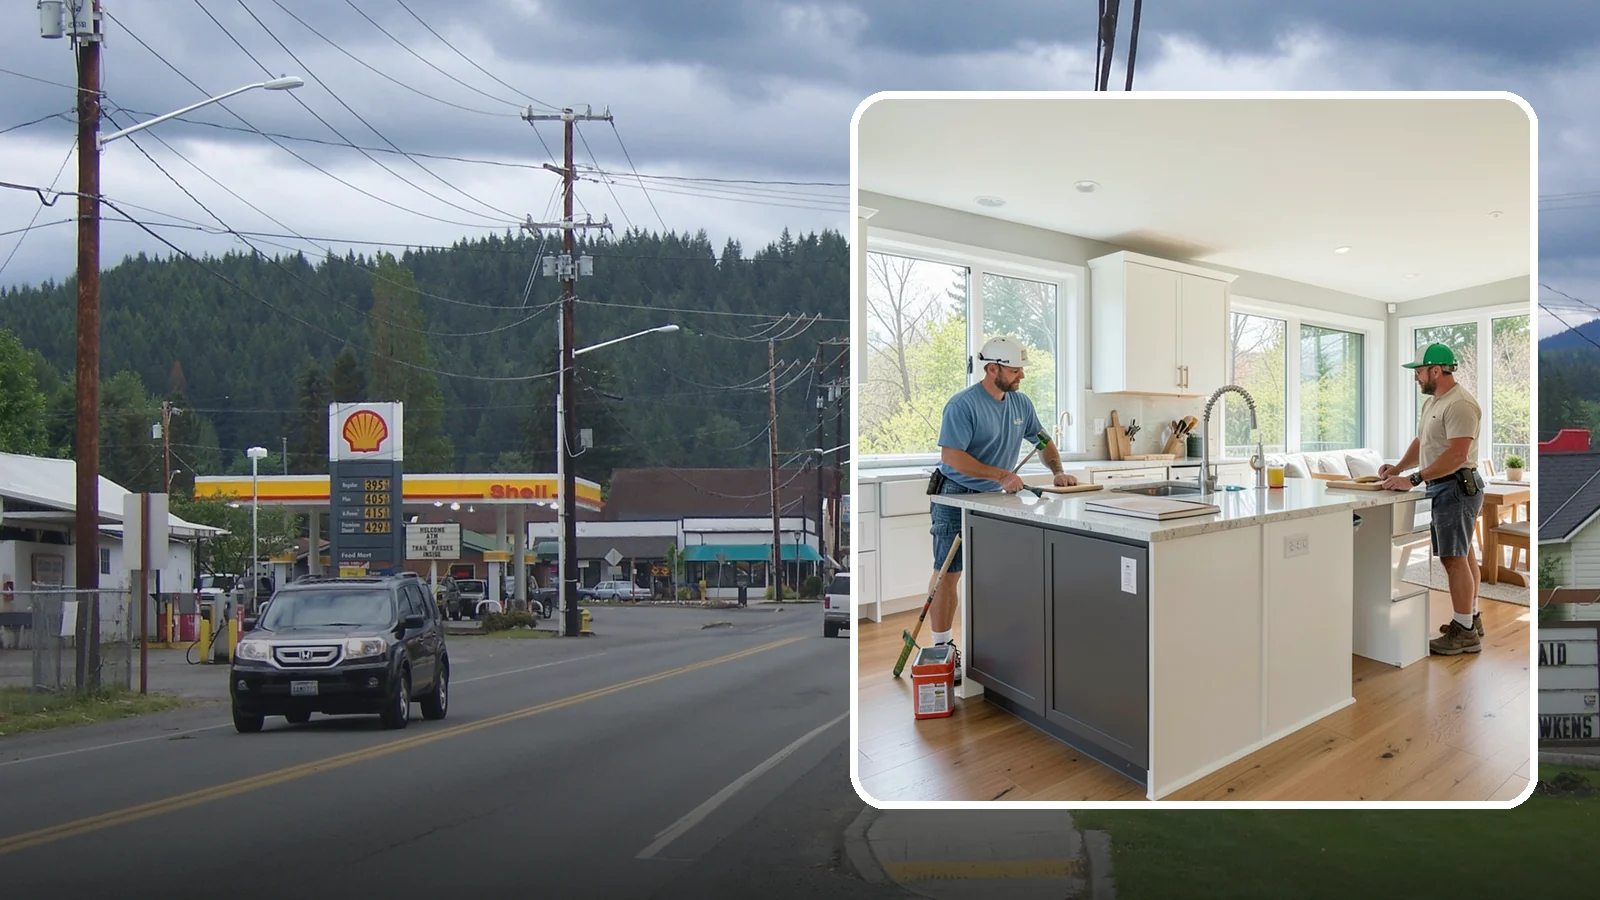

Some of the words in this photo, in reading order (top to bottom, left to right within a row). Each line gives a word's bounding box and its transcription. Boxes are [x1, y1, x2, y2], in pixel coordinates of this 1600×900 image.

[365, 480, 383, 490] 395
[490, 484, 547, 499] Shell
[365, 494, 383, 504] 405
[365, 508, 383, 518] 415
[365, 522, 383, 532] 429
